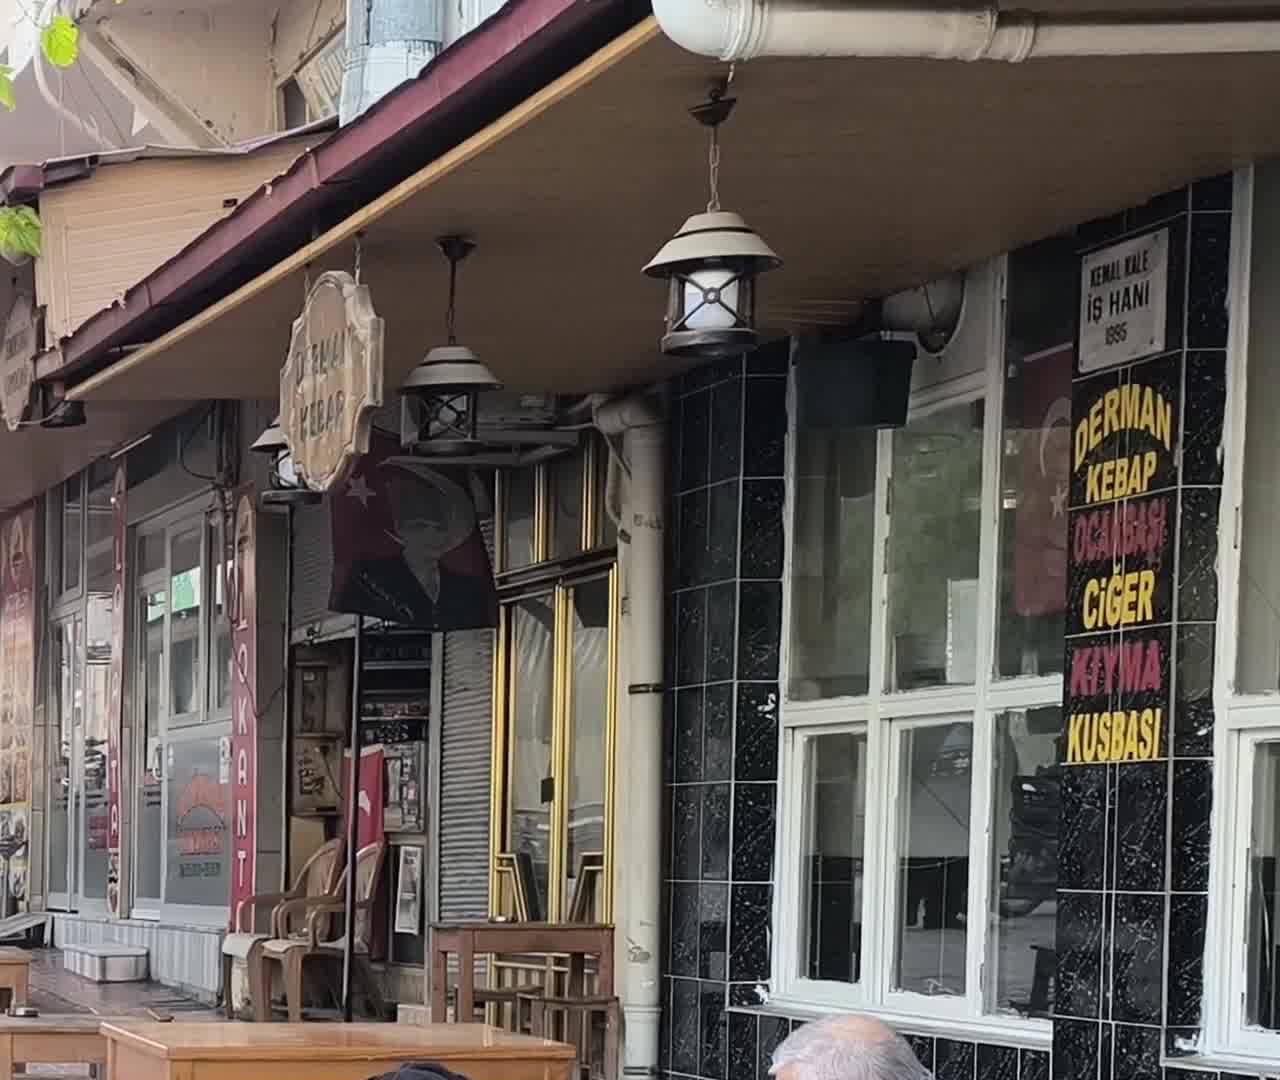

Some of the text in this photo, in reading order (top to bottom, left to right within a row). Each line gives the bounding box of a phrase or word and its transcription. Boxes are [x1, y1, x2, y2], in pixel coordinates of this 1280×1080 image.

[1109, 280, 1150, 316] HANI
[1073, 383, 1172, 472] DERMAN
[1086, 450, 1158, 504] KEBAP
[1071, 639, 1162, 697] KIYMA
